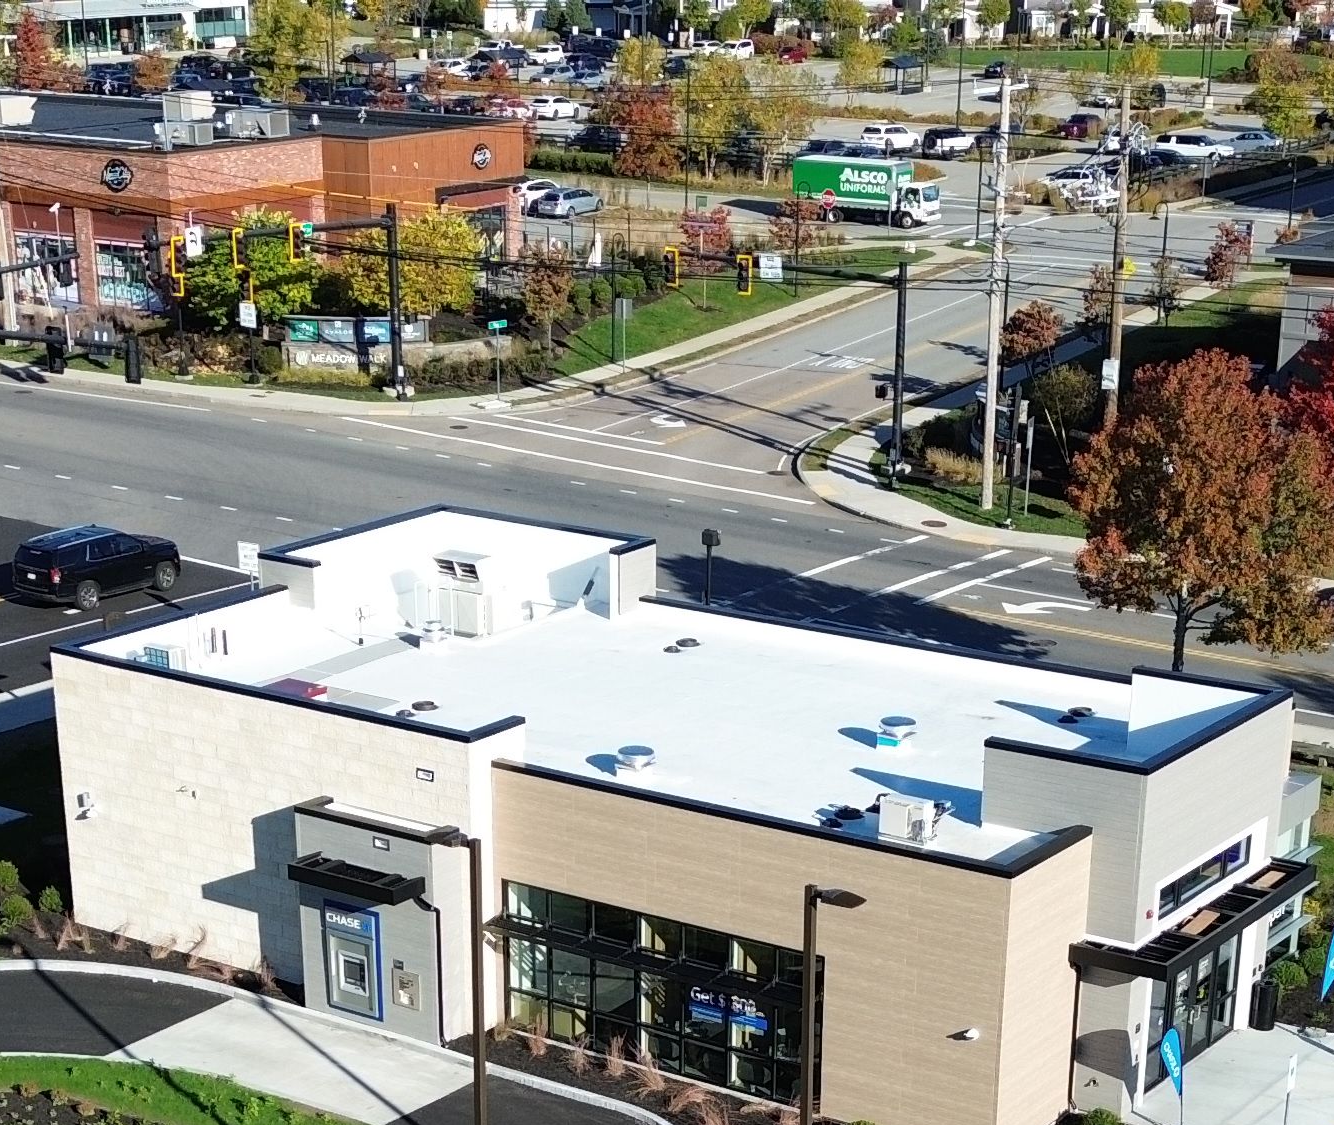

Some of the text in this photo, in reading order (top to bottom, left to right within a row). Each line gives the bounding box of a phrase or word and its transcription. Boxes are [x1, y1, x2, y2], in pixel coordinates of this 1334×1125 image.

[839, 168, 888, 183] ALSCO
[840, 182, 887, 195] UNIFORMS
[311, 354, 387, 364] MEADOW WALK
[326, 912, 361, 930] CHASE
[690, 986, 715, 1006] Get
